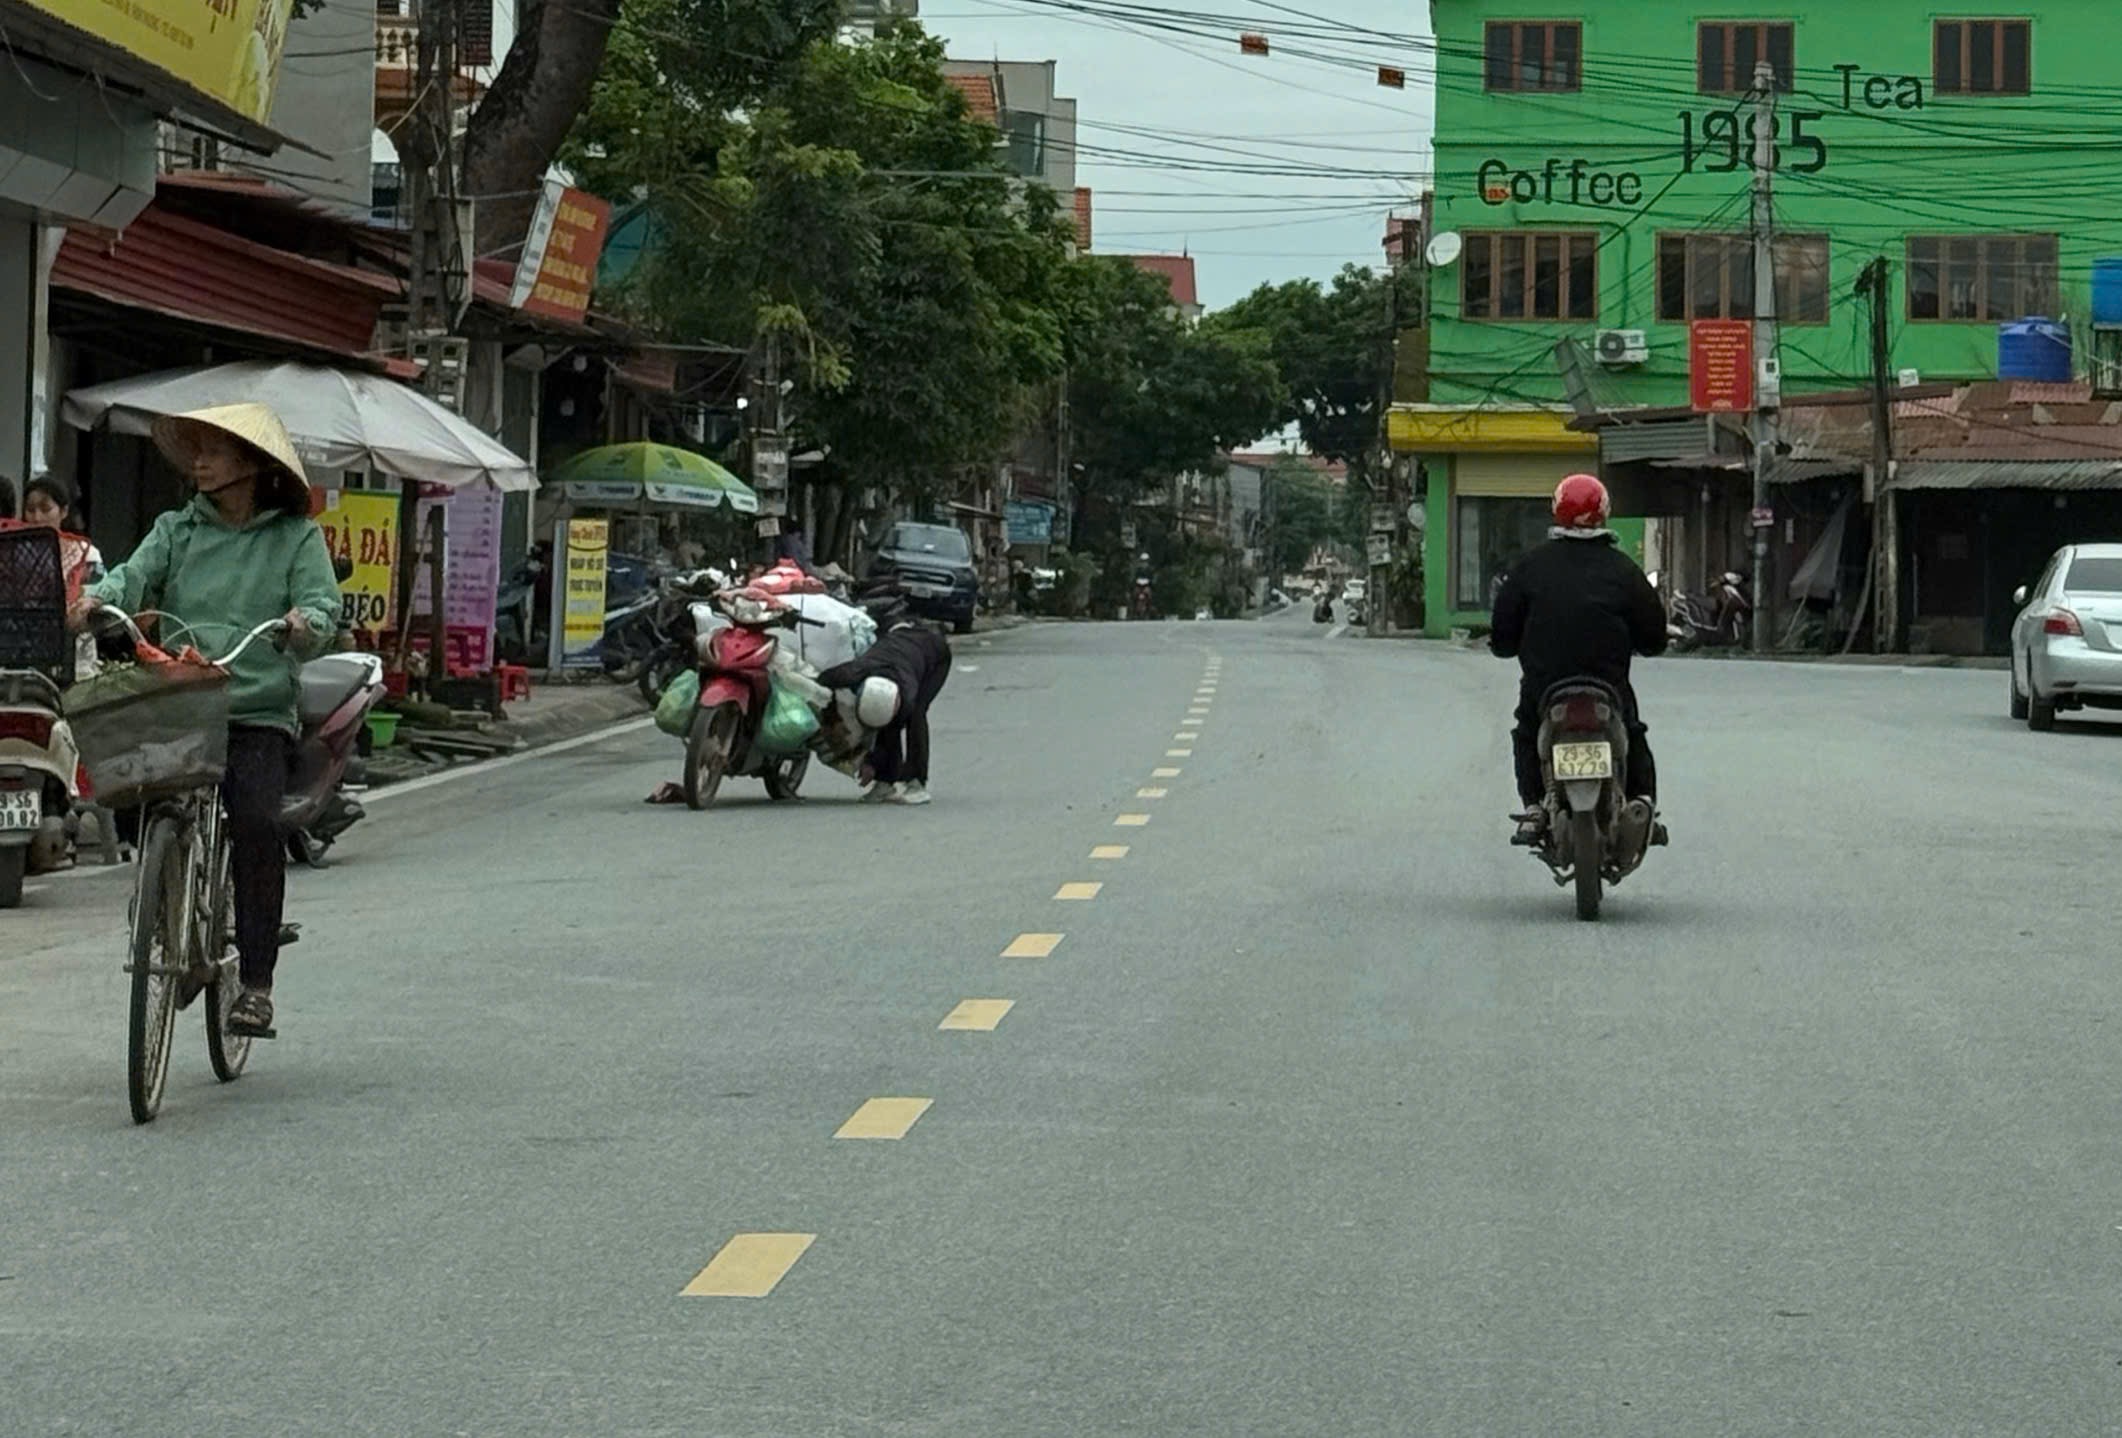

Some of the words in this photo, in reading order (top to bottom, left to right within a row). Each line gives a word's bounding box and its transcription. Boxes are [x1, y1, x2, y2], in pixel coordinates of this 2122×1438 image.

[1832, 64, 1924, 111] Tea
[1678, 110, 1828, 174] 1985
[1477, 158, 1643, 206] Coffee
